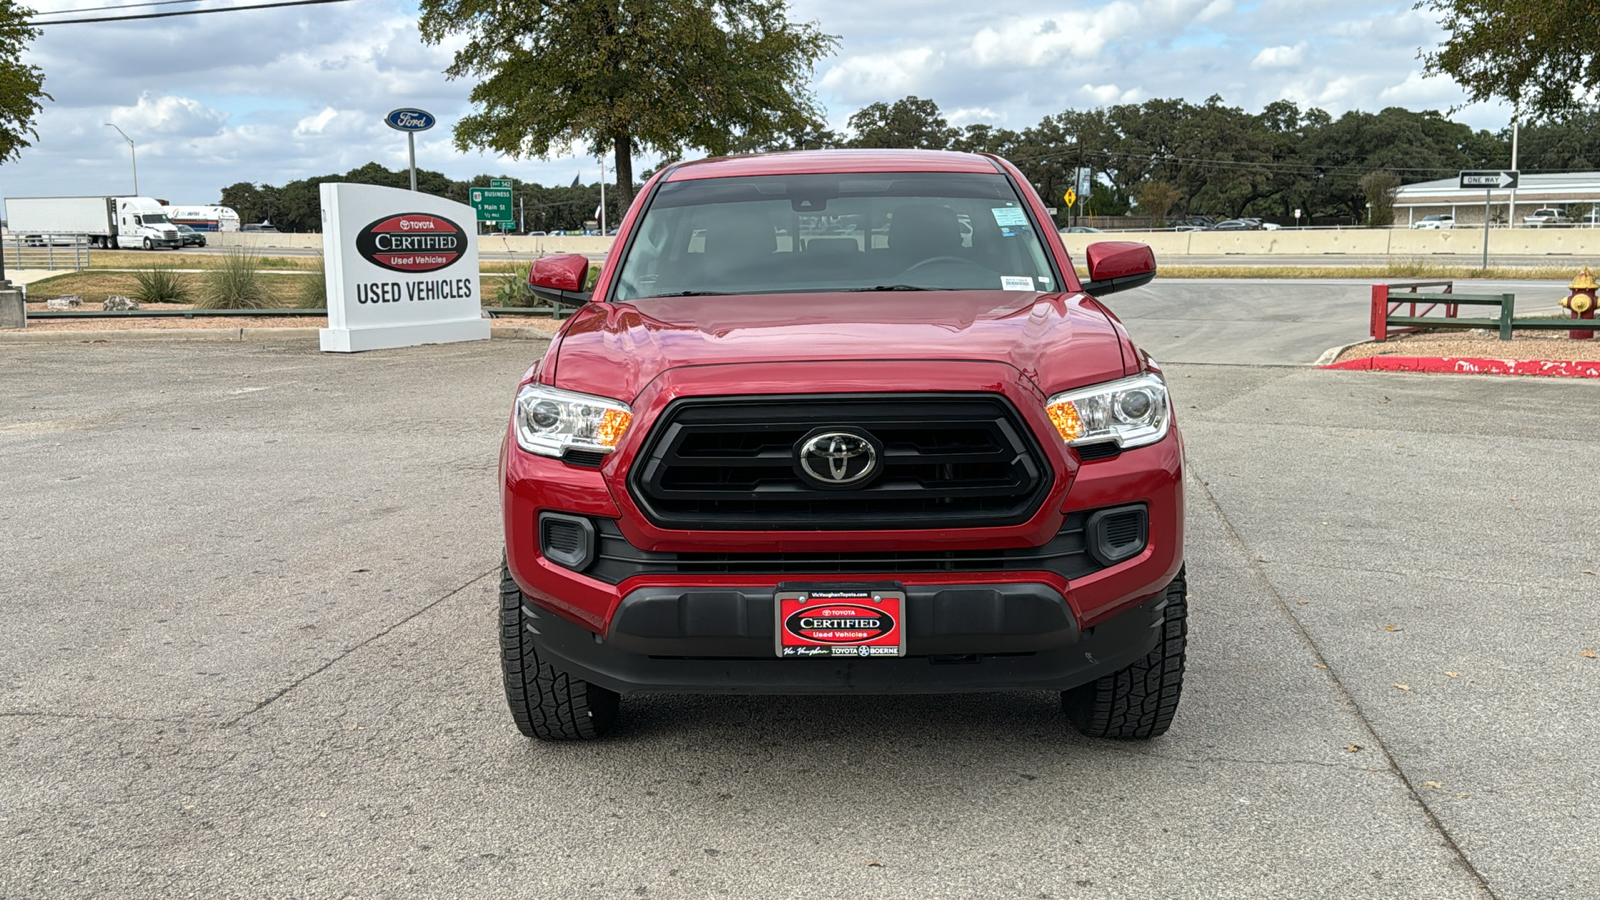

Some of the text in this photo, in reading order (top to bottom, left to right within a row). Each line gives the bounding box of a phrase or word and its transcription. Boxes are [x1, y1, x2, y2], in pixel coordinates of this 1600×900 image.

[397, 111, 426, 127] Ford
[409, 221, 435, 229] TOYOTA
[375, 233, 458, 250] CERTIFIED
[391, 255, 447, 265] Used Vehicles
[356, 278, 472, 304] USED VEHICLES
[800, 618, 880, 629] CERTIFIED
